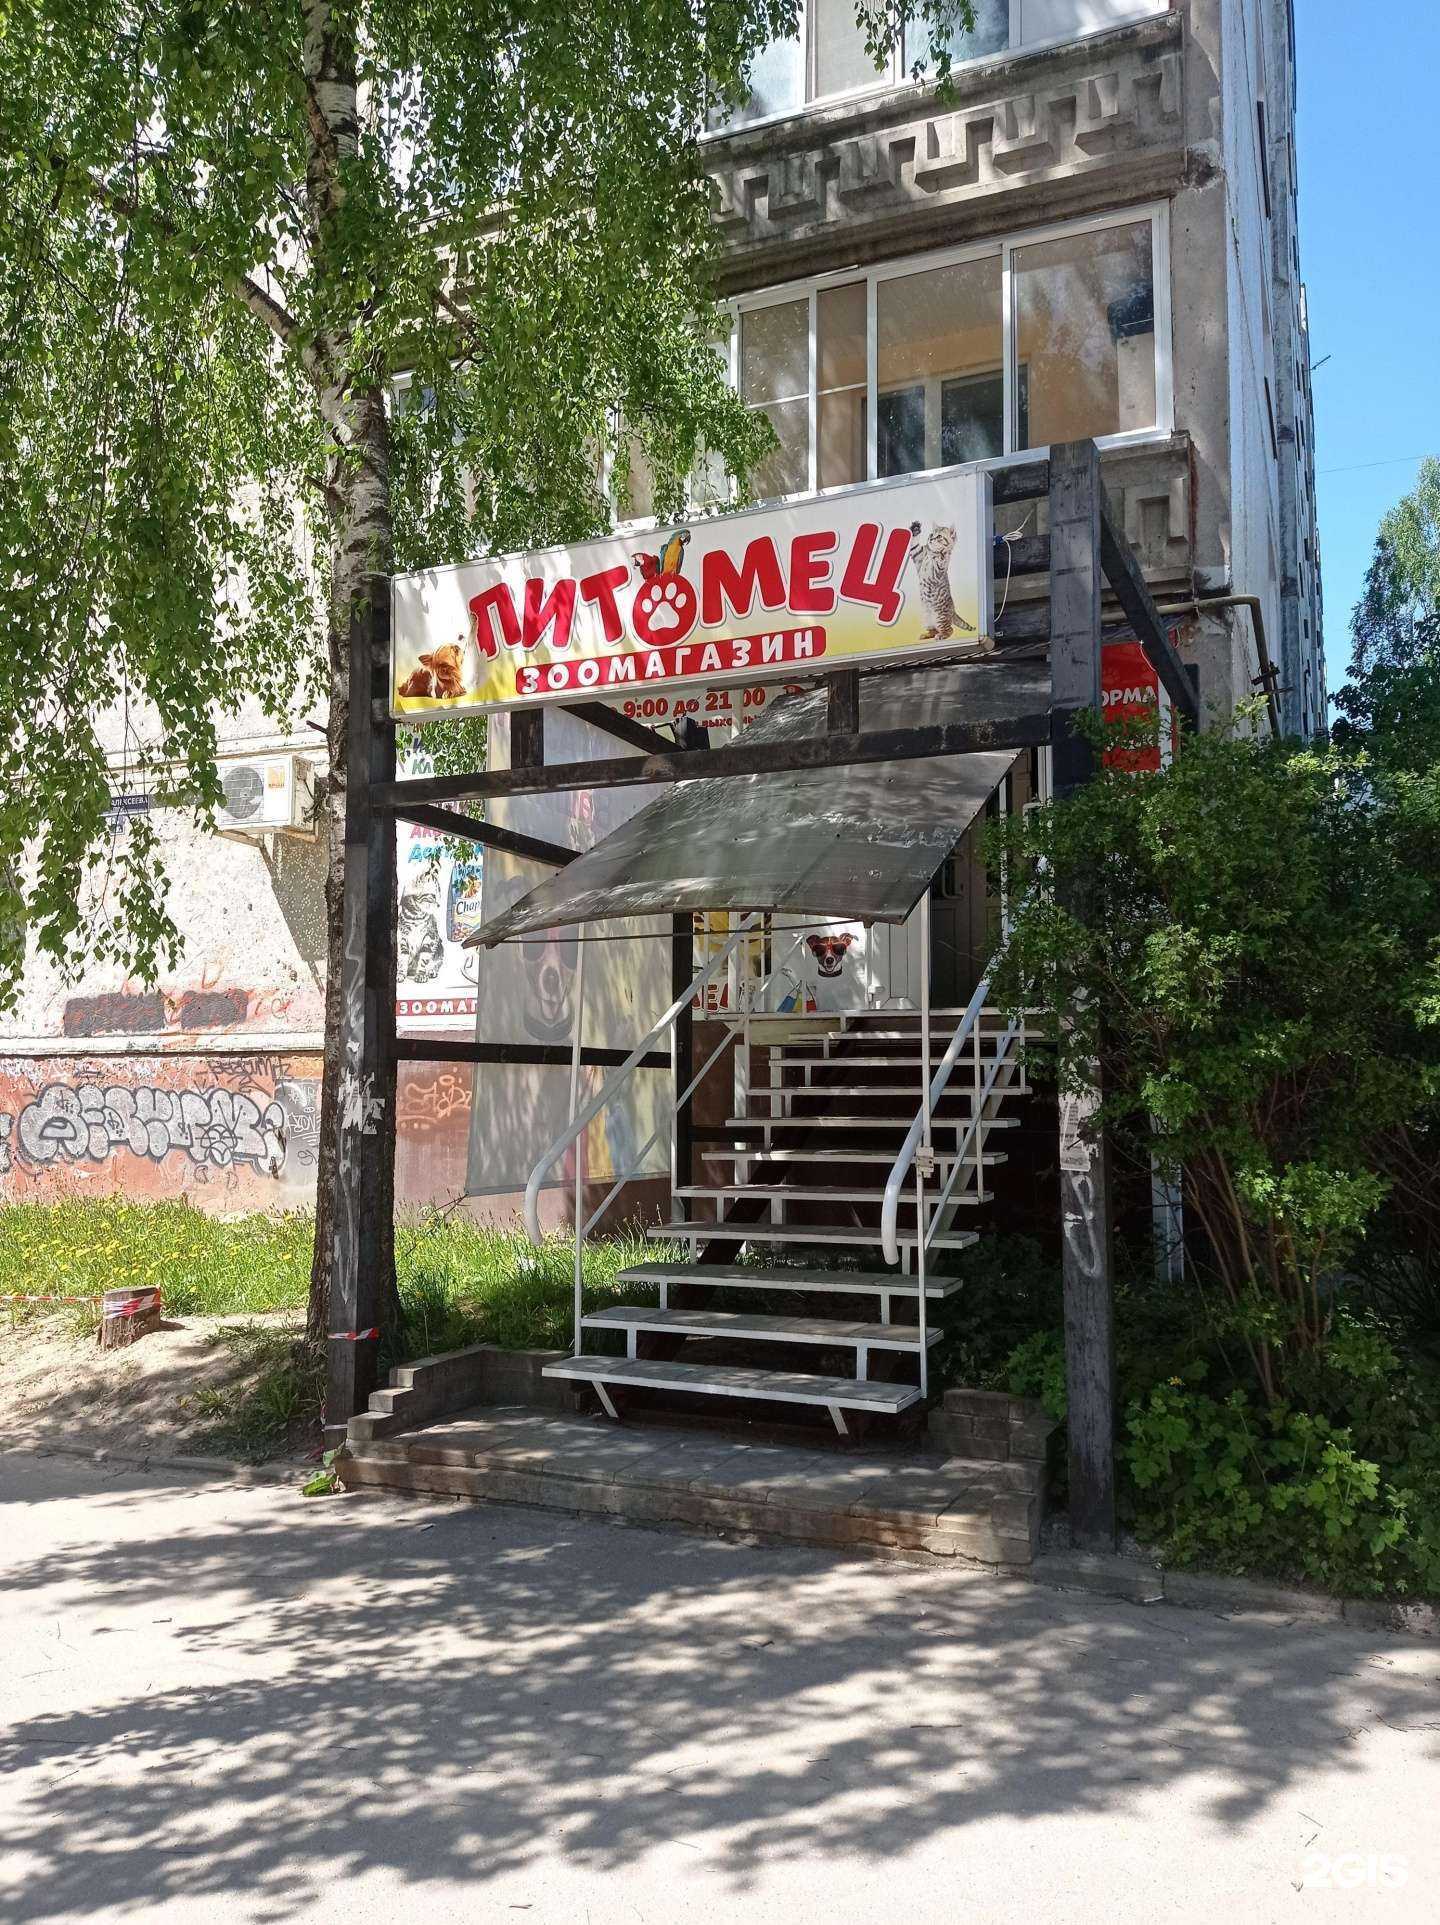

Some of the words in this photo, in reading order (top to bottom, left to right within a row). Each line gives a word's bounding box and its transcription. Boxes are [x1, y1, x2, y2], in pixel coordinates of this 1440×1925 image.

[466, 522, 914, 660] ПИТОМЕЦ
[521, 628, 815, 694] ЗООМАГАЗИН
[623, 697, 668, 720] 9:00
[672, 698, 700, 718] до
[705, 688, 766, 712] 2100
